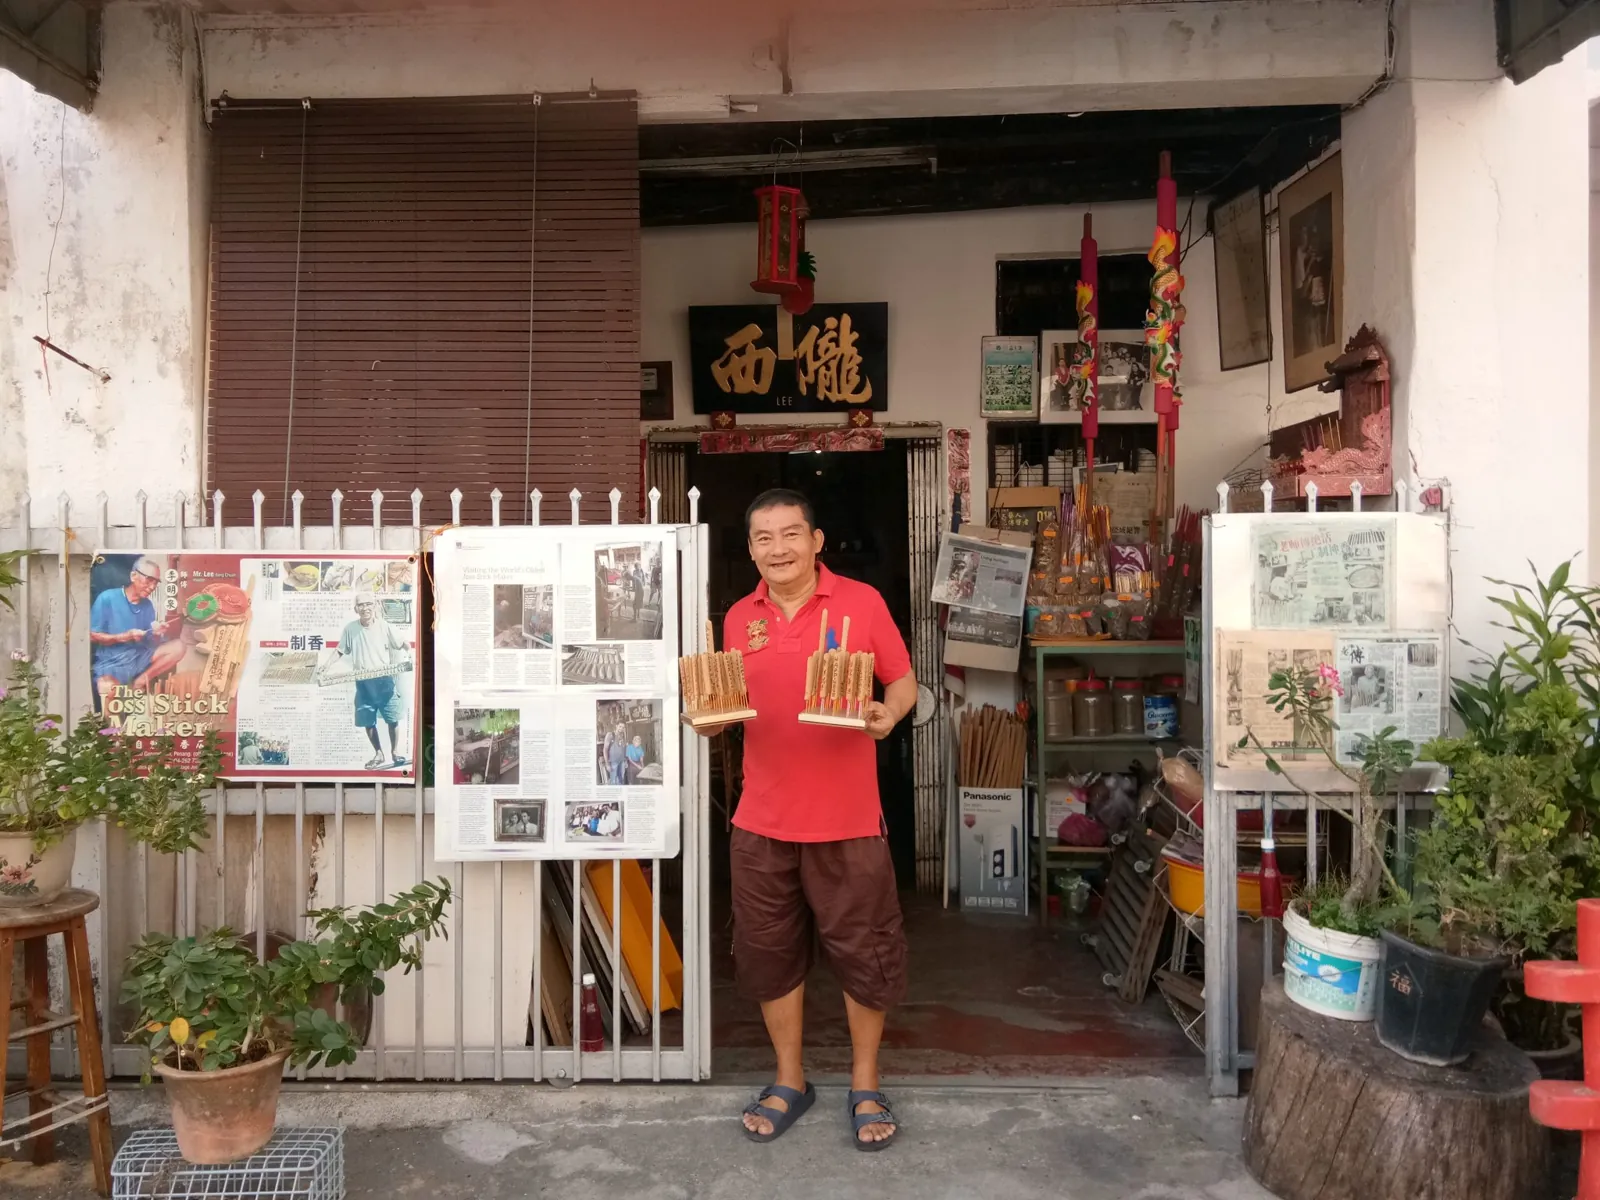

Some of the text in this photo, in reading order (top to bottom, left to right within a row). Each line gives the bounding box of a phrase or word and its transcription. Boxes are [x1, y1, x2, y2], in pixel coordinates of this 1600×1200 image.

[776, 396, 792, 406] LEE
[192, 570, 203, 578] Mr.
[203, 570, 214, 578] Lee
[488, 566, 498, 574] the
[290, 634, 324, 651] 制香
[113, 685, 143, 699] The
[153, 692, 229, 715] Stick
[109, 715, 210, 738] Maker
[963, 791, 1012, 801] Panasonic
[1389, 970, 1412, 996] 福
